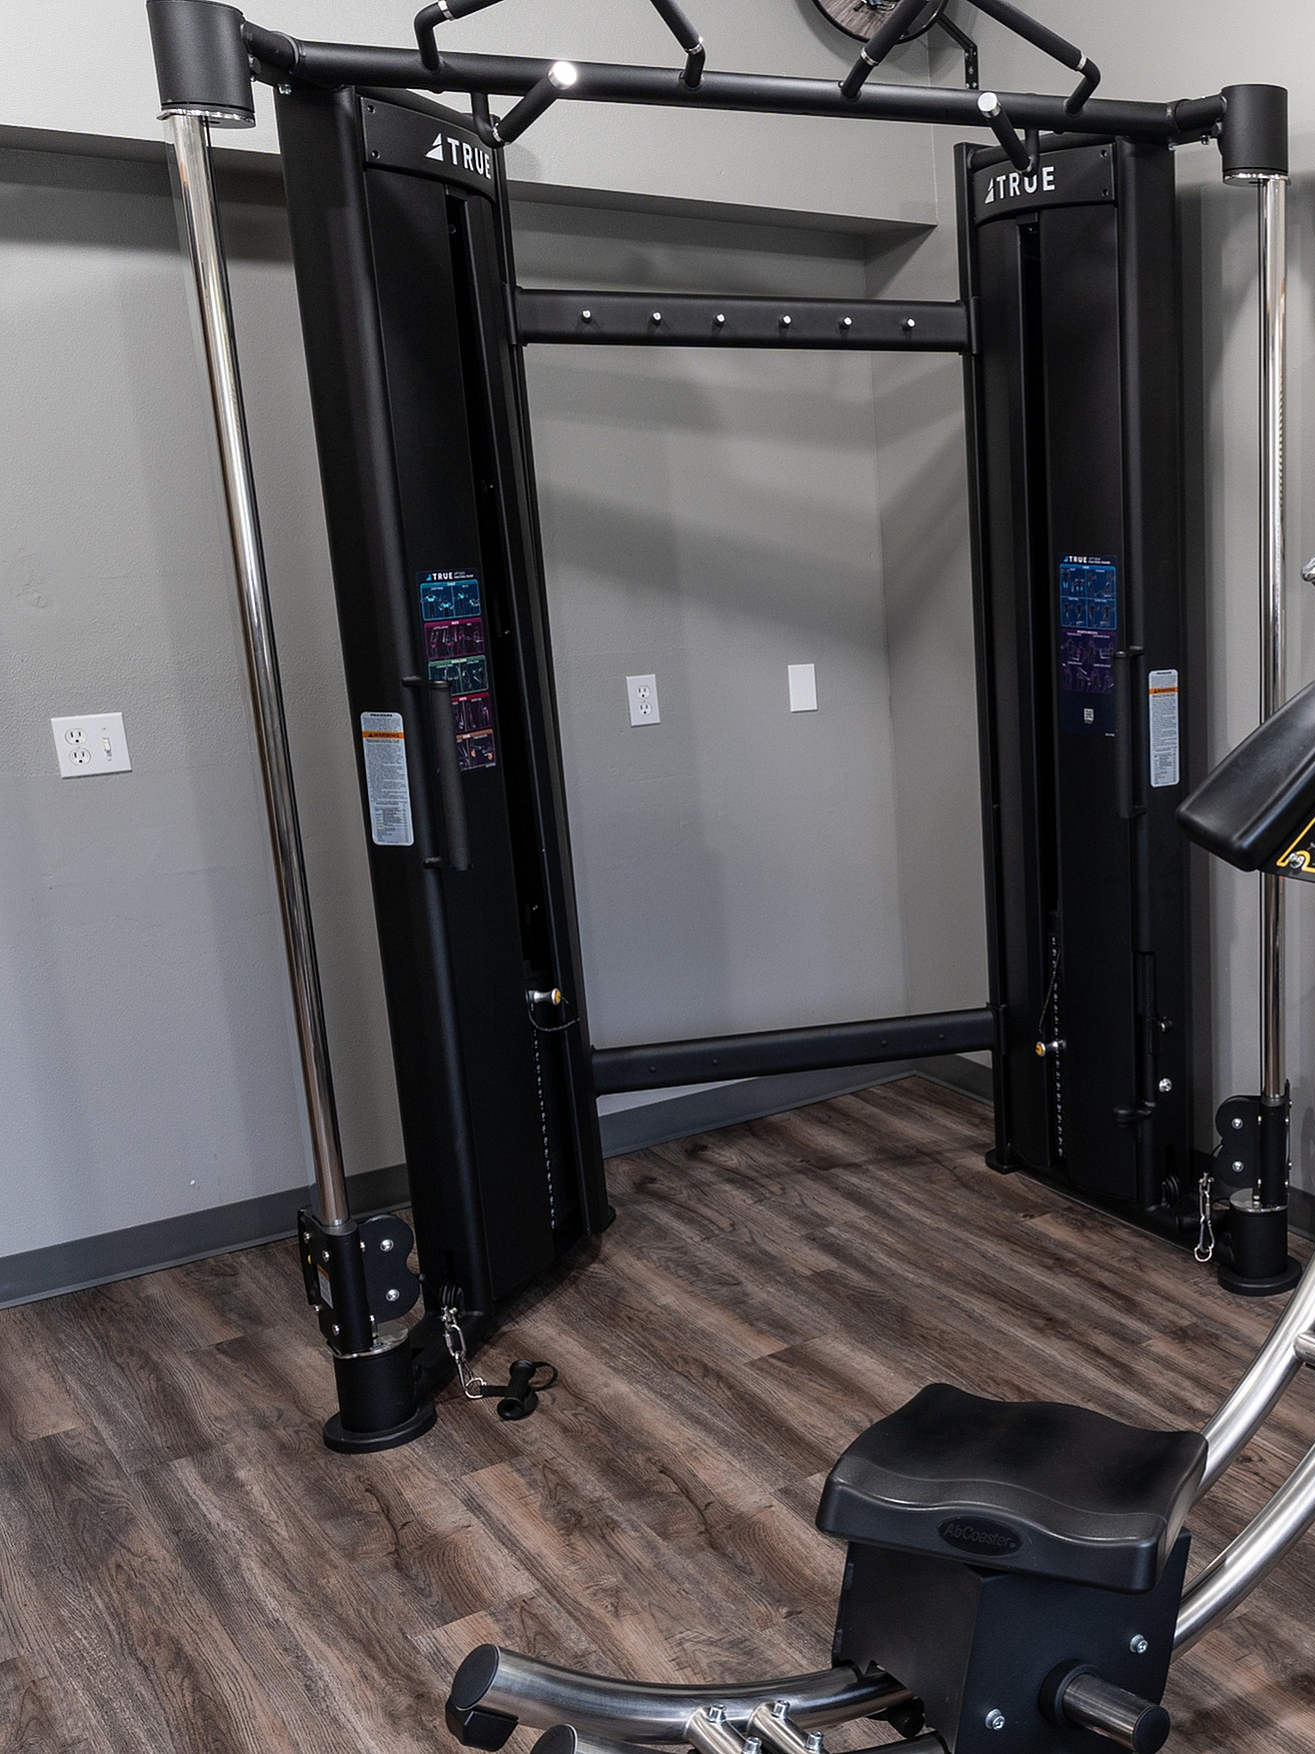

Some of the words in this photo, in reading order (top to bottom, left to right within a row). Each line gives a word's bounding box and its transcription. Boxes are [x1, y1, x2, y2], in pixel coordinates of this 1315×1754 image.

[446, 137, 492, 180] TRUE
[996, 165, 1056, 199] TRUE
[1068, 555, 1087, 564] TRUE
[432, 571, 453, 581] TRUE
[943, 1523, 1013, 1547] AbCoaster
